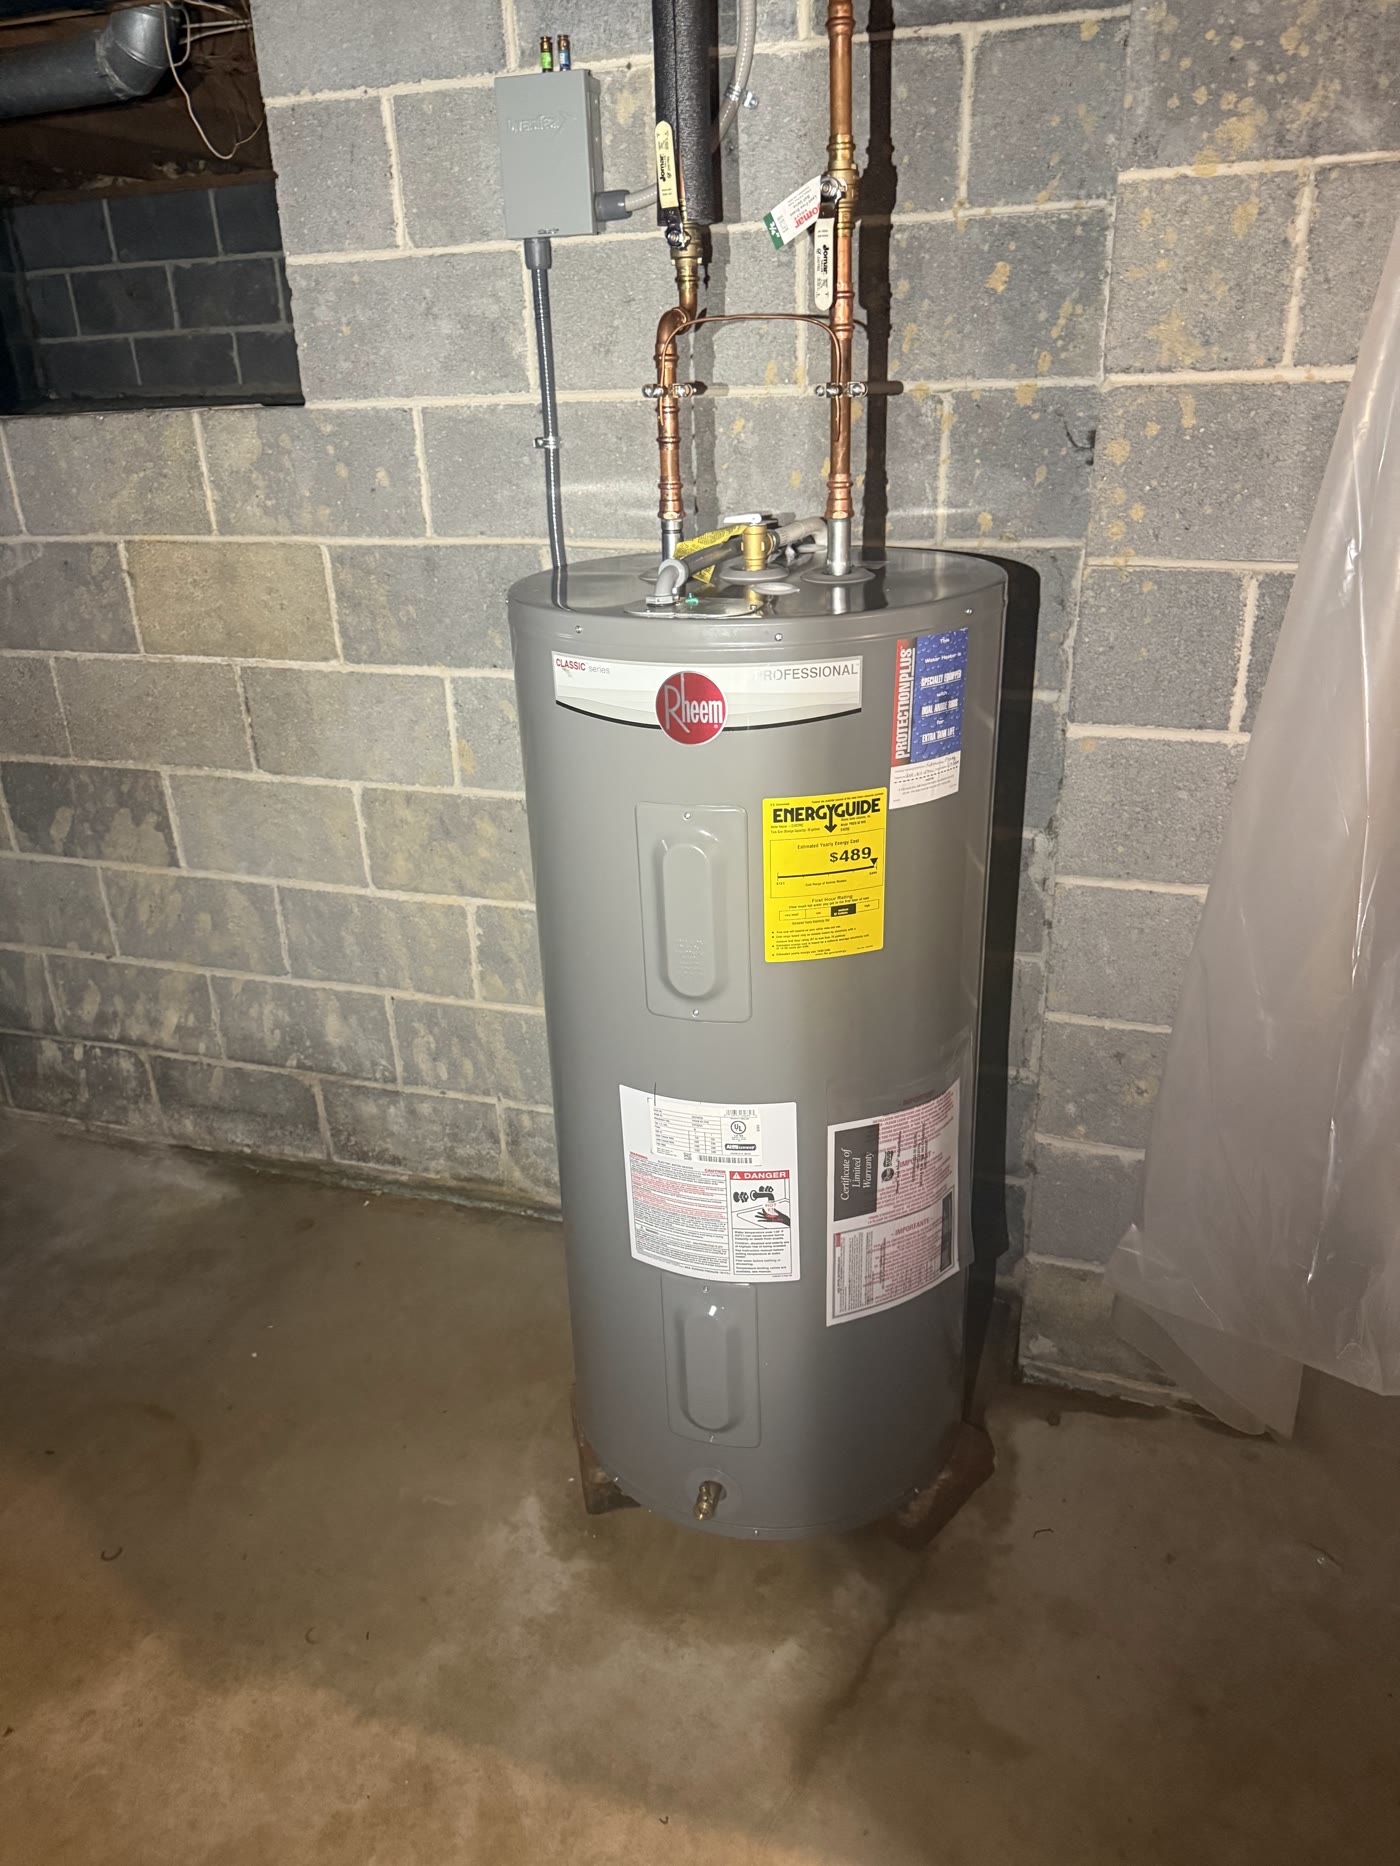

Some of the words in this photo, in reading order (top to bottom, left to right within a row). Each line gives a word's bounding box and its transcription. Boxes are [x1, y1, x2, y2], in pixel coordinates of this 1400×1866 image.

[822, 244, 830, 274] Jomar
[556, 658, 586, 671] CLASSIC
[588, 664, 611, 674] series
[663, 672, 724, 733] Rheem
[895, 648, 913, 759] PROTECTIONPLUS
[773, 798, 881, 823] ENERGYGUIDE
[829, 847, 872, 863] $489
[841, 1147, 852, 1157] of
[840, 1159, 852, 1201] Certificate
[852, 1157, 861, 1188] Limited
[863, 1151, 874, 1188] Warranty
[895, 1217, 930, 1235] IMPORTANTE
